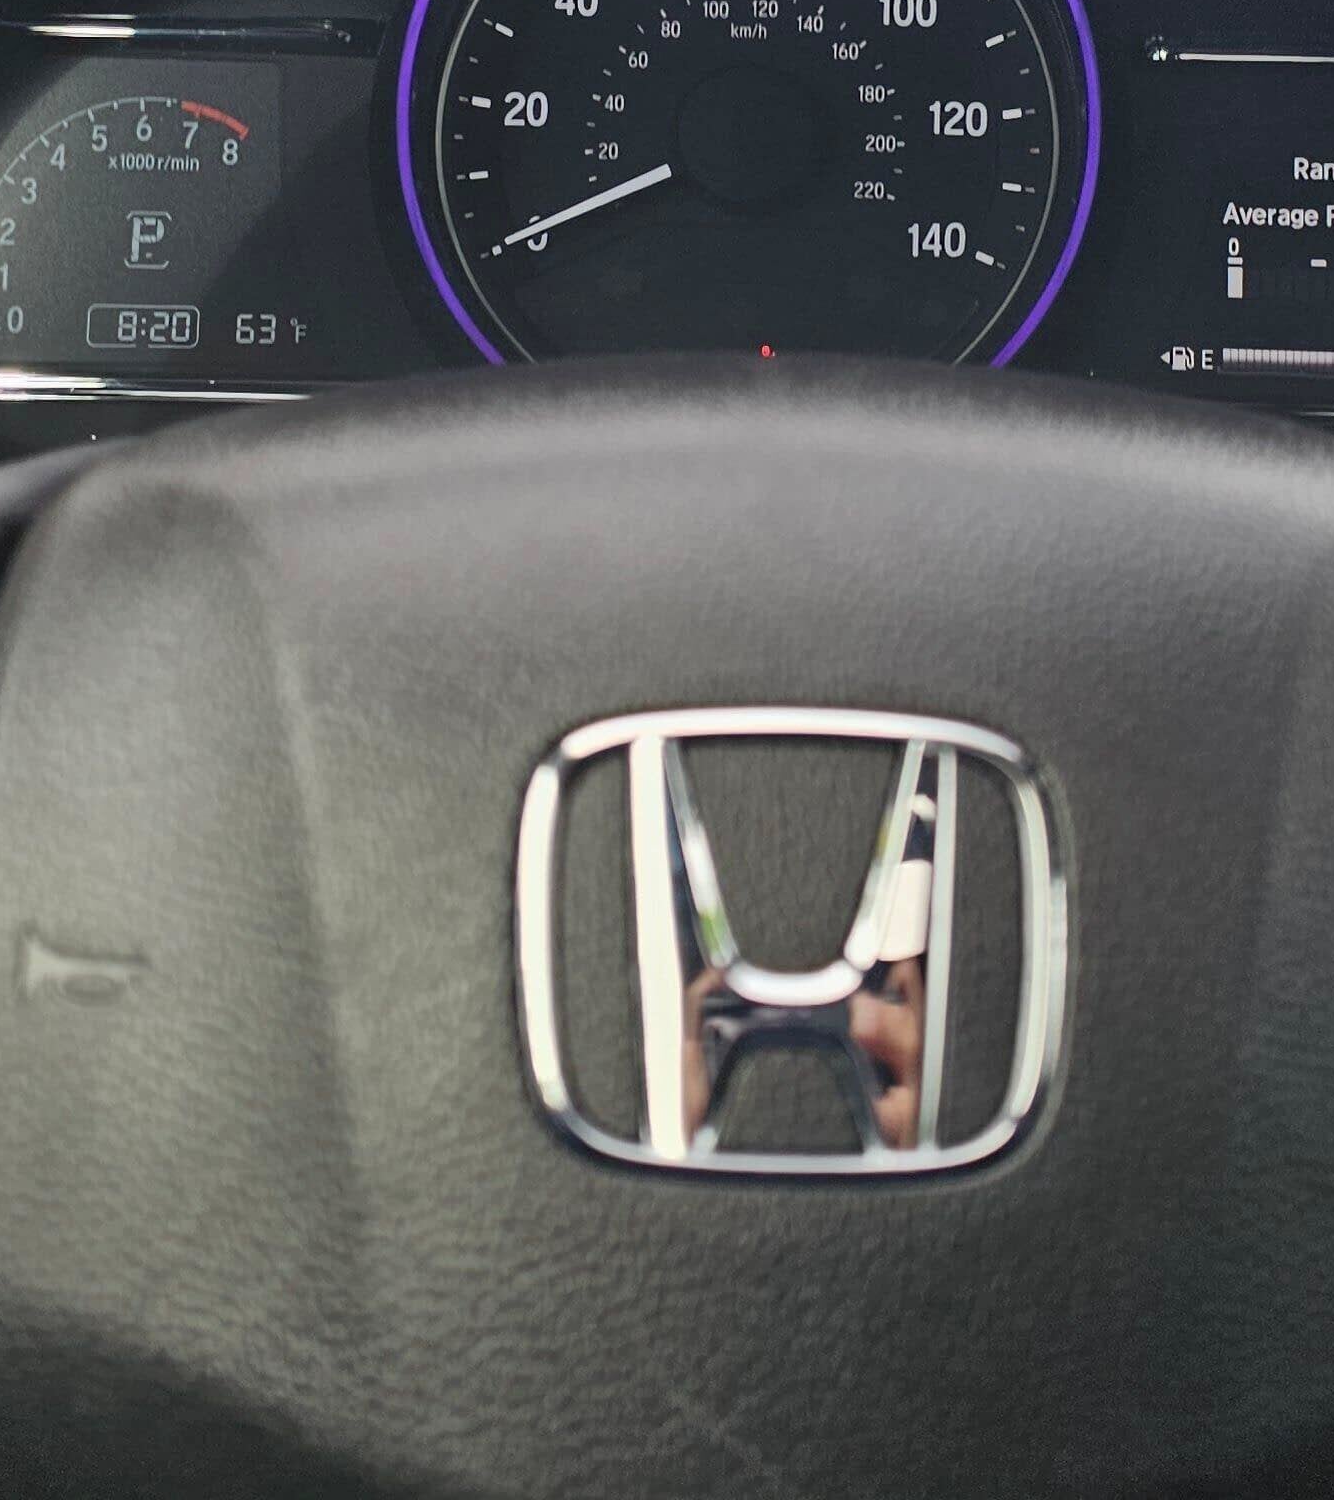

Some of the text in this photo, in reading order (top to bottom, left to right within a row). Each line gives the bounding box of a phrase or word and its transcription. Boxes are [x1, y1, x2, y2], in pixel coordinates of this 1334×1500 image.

[703, 0, 730, 19] 100
[752, 0, 779, 18] 120
[660, 20, 681, 39] 80
[730, 22, 767, 39] km/h
[797, 14, 824, 33] 140
[628, 50, 649, 69] 60
[832, 42, 859, 61] 160
[604, 94, 625, 112] 40
[858, 84, 885, 103] 180
[503, 91, 549, 127] 20
[929, 100, 988, 137] 120
[91, 124, 108, 152] 5
[136, 114, 153, 142] 6
[182, 121, 199, 150] 7
[49, 143, 66, 171] 4
[222, 138, 239, 166] 8
[598, 142, 619, 160] 20
[865, 134, 896, 153] 200
[20, 177, 37, 205] 3
[854, 181, 885, 199] 220
[1222, 201, 1319, 230] Average
[0, 217, 16, 246] 2
[130, 216, 166, 264] P
[907, 221, 966, 258] 140
[1228, 237, 1240, 256] 0
[0, 264, 9, 291] 1
[7, 305, 24, 334] 0
[117, 310, 191, 342] 8:20
[1201, 349, 1214, 370] E
